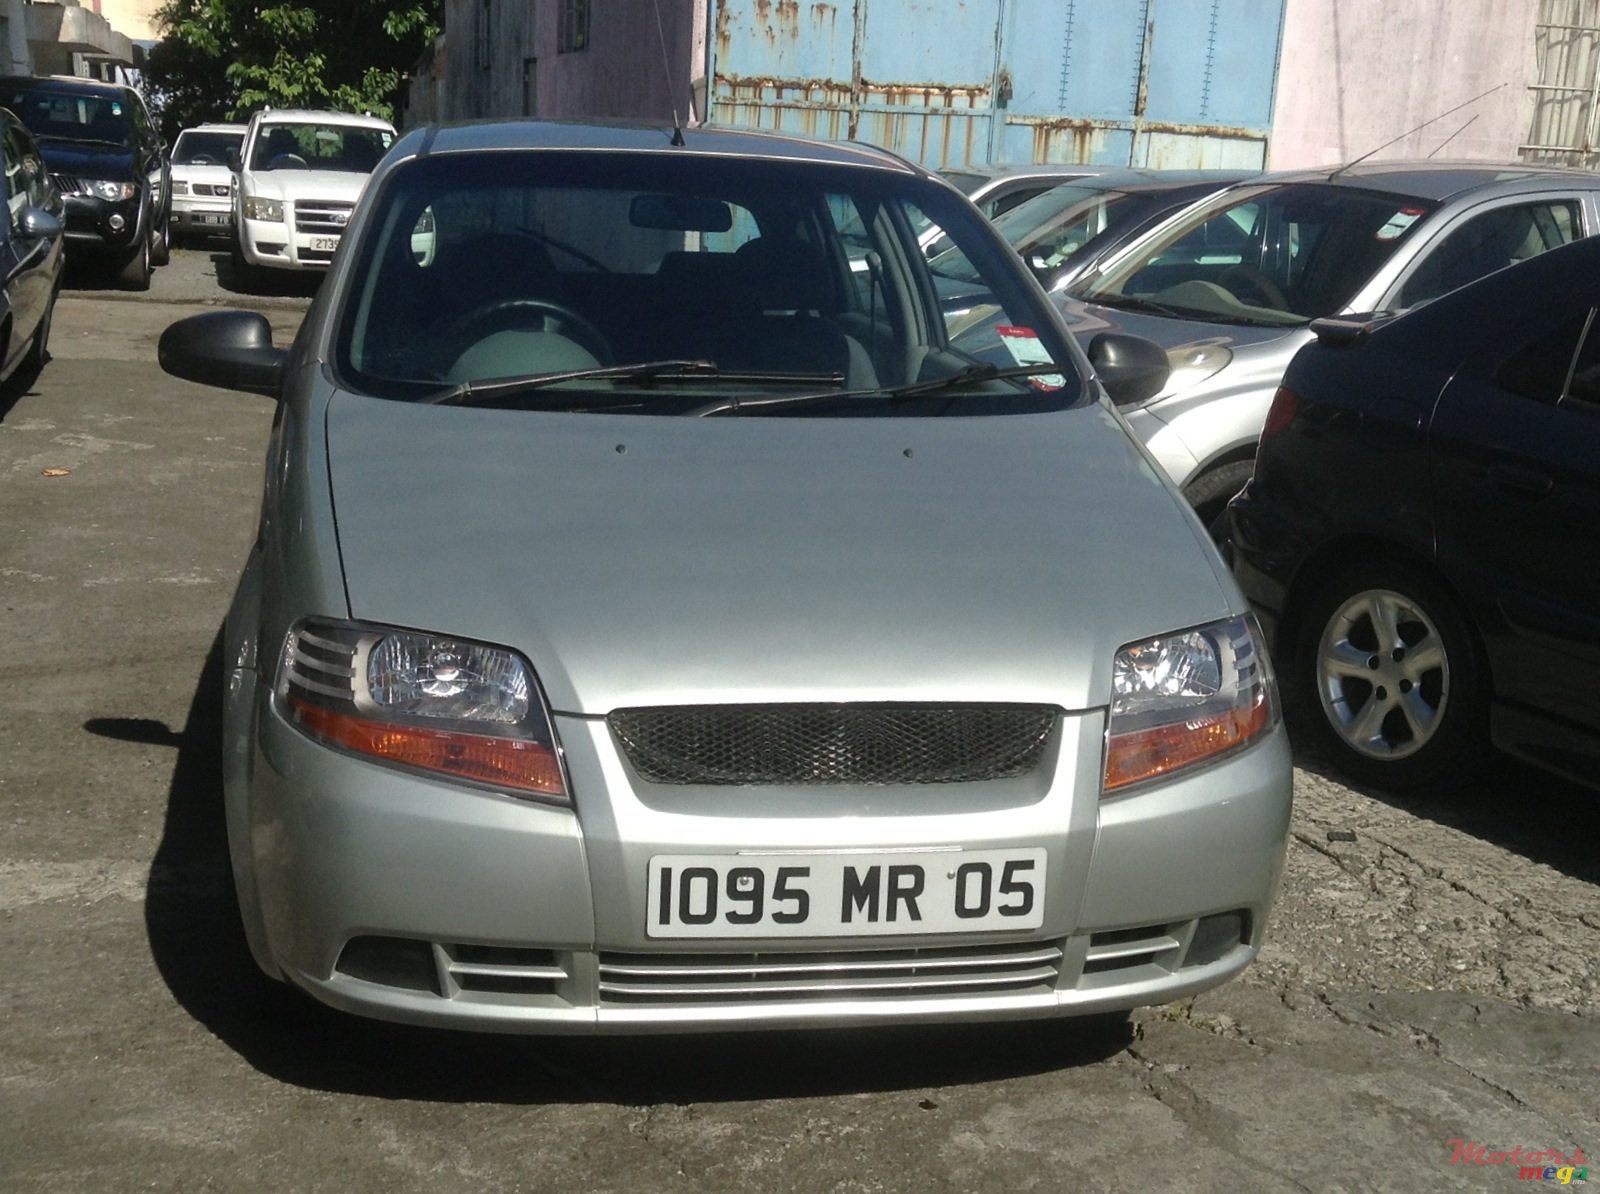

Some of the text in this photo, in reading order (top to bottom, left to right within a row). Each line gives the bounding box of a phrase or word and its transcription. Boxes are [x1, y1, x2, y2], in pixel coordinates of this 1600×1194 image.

[659, 859, 1035, 925] 1095 MR 05
